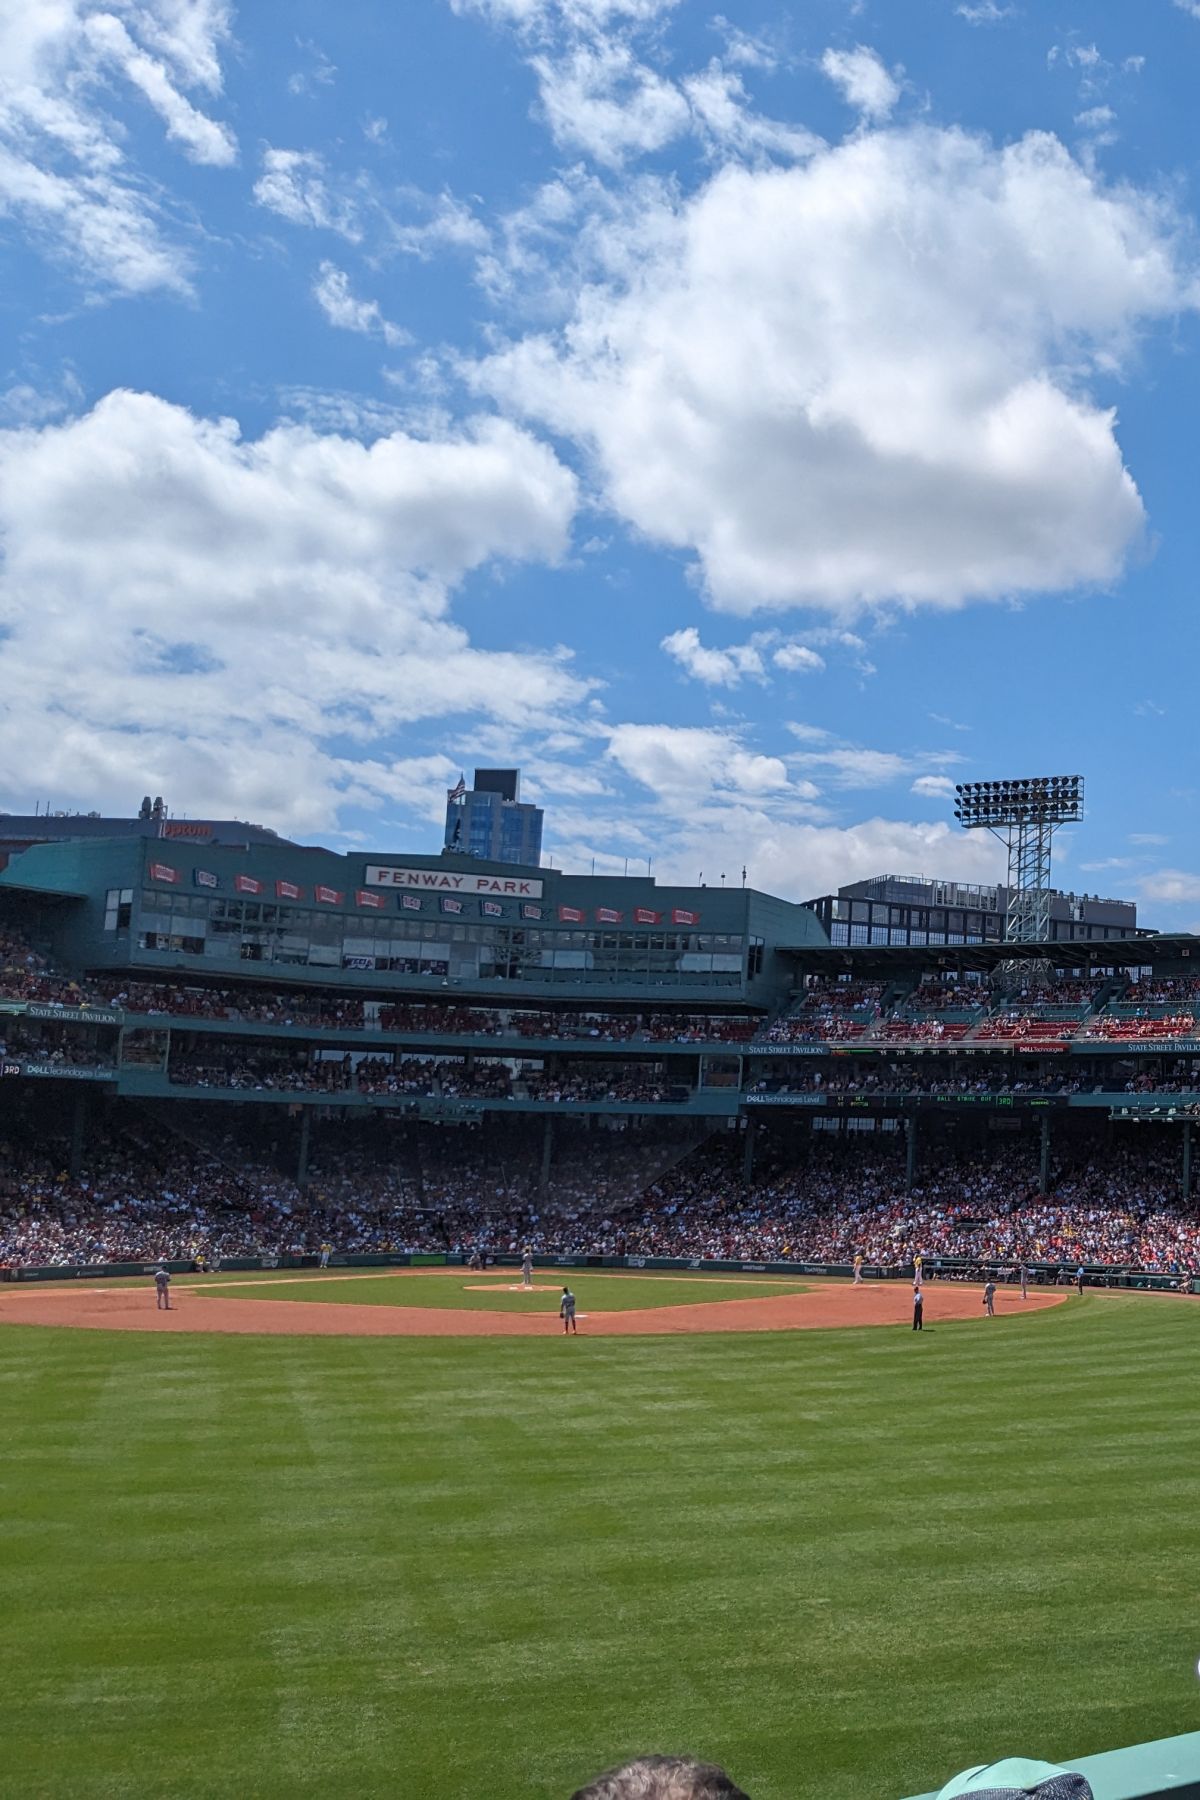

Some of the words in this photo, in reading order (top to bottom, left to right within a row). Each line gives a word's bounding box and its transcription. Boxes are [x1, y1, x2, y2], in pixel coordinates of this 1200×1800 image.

[378, 871, 464, 888] FENWAY
[477, 879, 531, 894] PARK
[30, 1007, 52, 1017] STATE
[53, 1009, 79, 1019] STREET
[82, 1011, 116, 1022] PAVILION
[792, 1046, 823, 1054] PAVILION
[4, 1065, 20, 1075] 3RD
[999, 1097, 1011, 1105] 3RD
